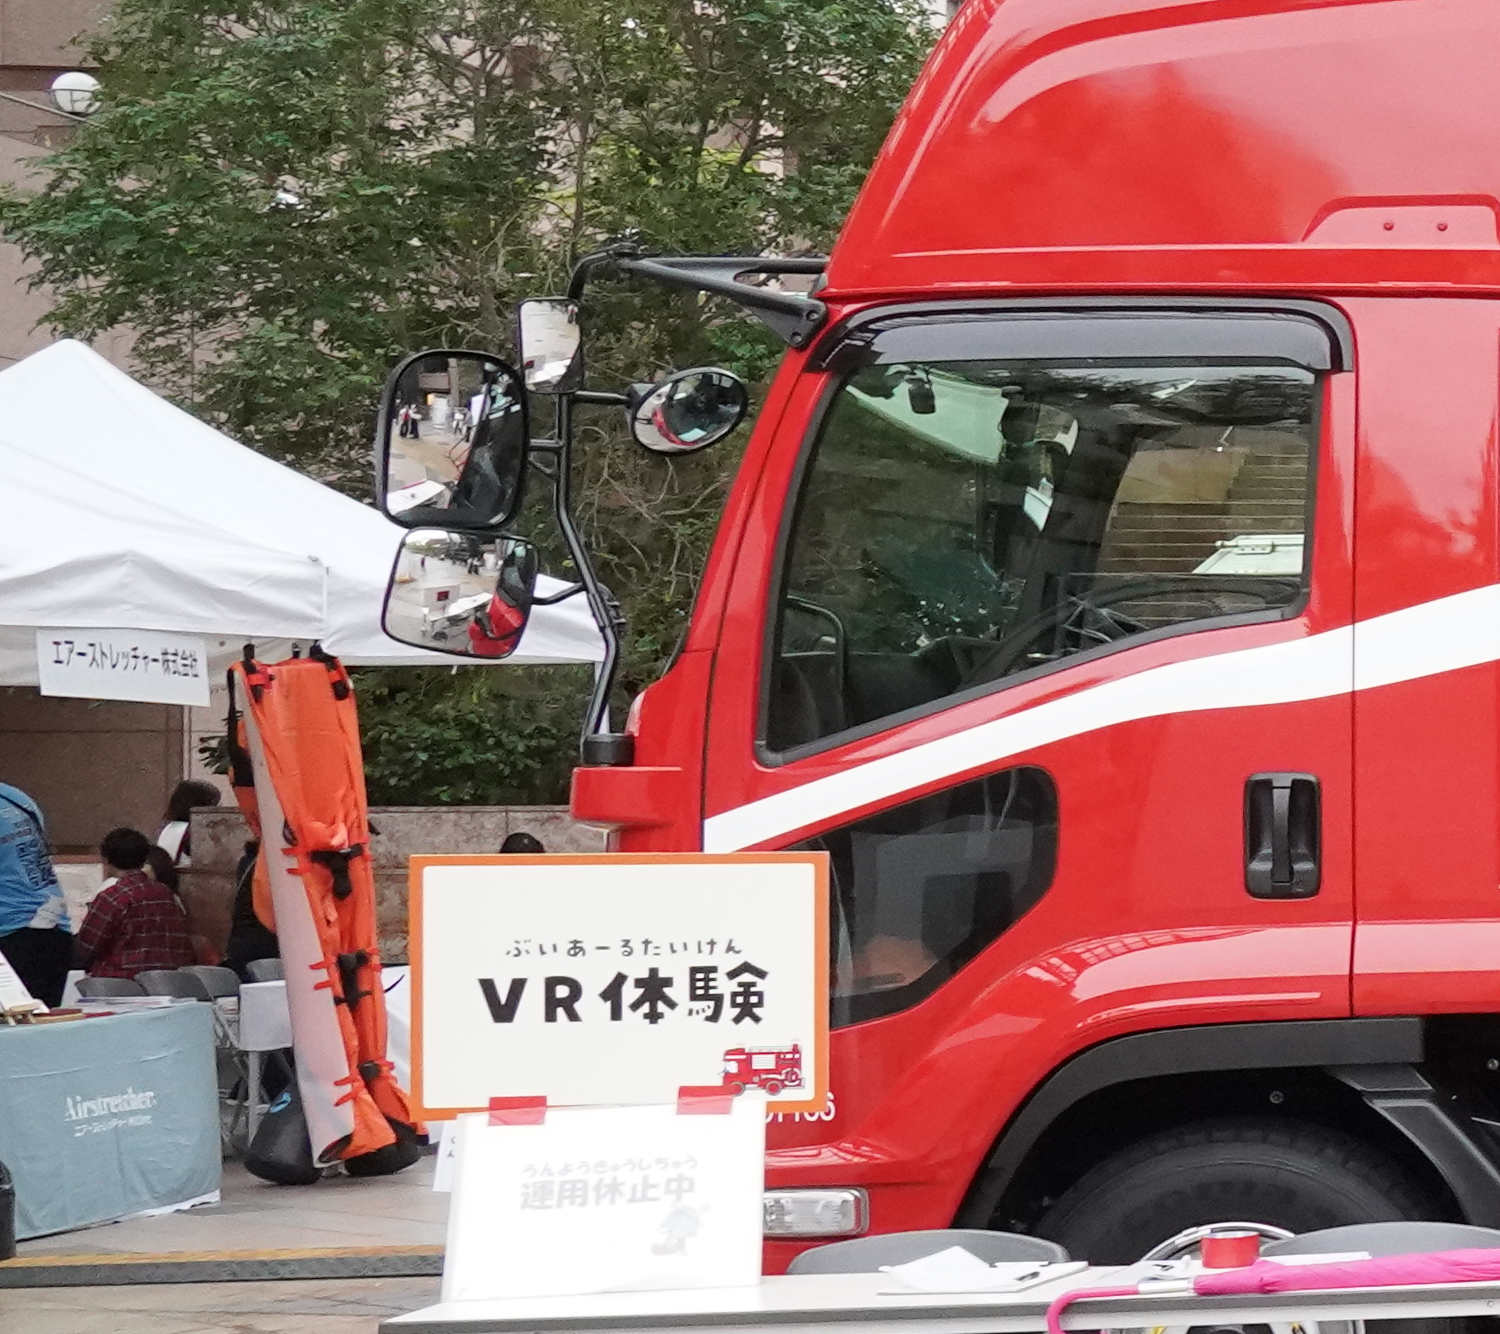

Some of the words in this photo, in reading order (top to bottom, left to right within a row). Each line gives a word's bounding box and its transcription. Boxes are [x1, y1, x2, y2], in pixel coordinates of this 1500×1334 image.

[506, 938, 743, 958] ぶいあーるたいけん
[478, 960, 769, 1025] VR体験
[519, 1171, 697, 1211] 運用休止中
